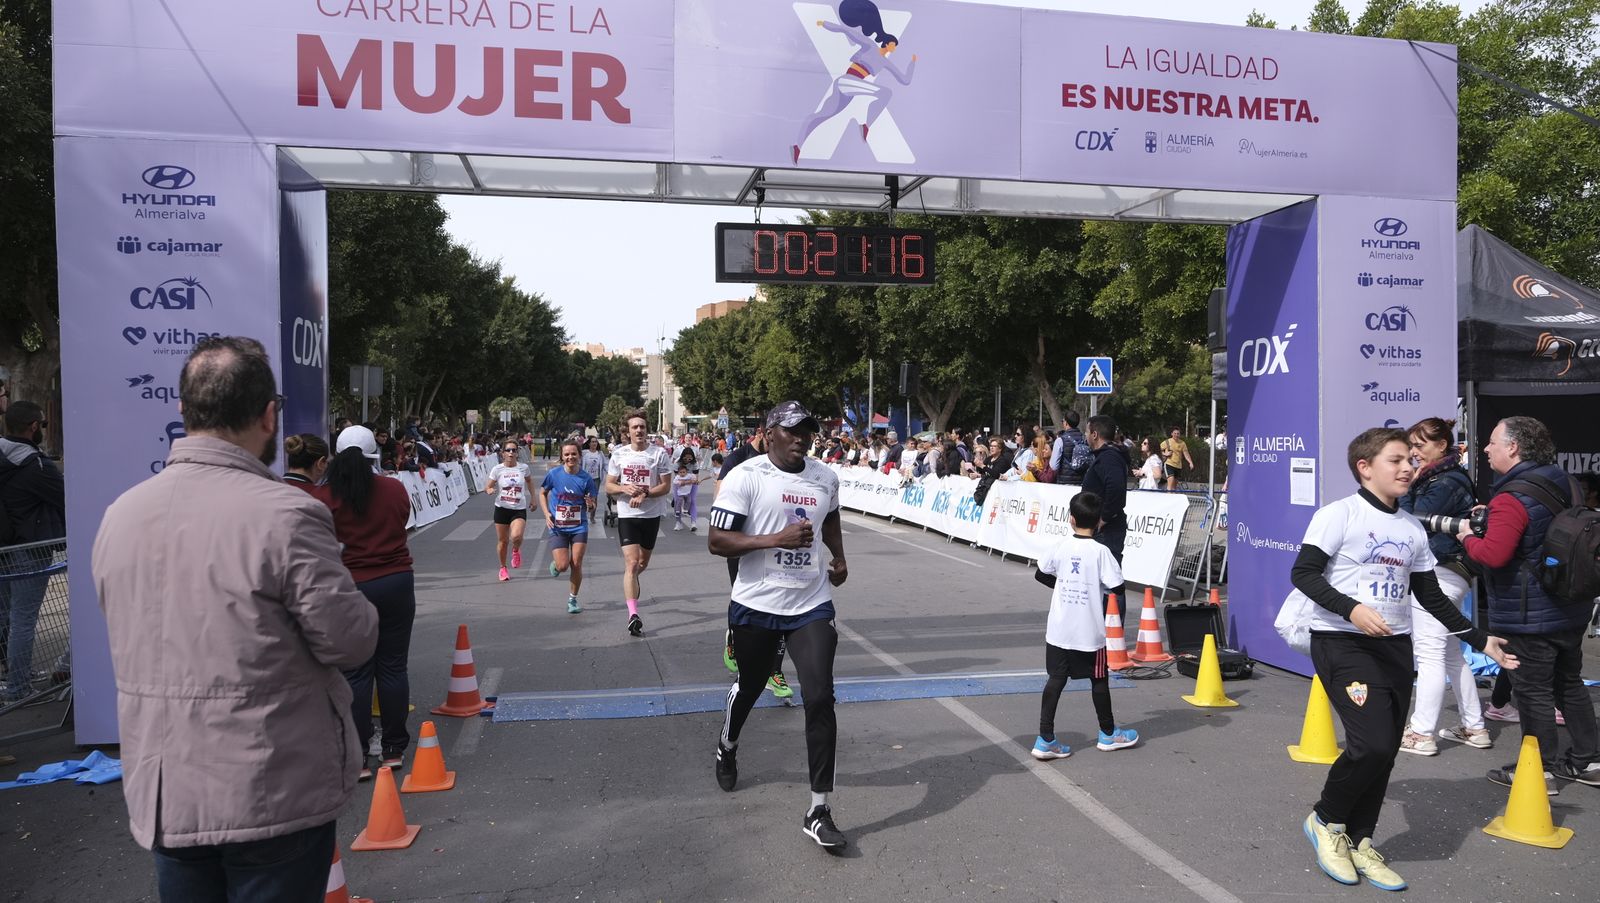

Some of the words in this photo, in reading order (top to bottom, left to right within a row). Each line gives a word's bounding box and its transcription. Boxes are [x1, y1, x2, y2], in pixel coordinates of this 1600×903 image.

[317, 0, 496, 28] CARRERA
[509, 2, 555, 32] DE
[569, 5, 612, 35] LA
[1106, 45, 1138, 70] LA
[1146, 48, 1279, 81] IGUALDAD
[297, 33, 631, 124] MUJER
[1062, 83, 1097, 109] ES
[1104, 85, 1233, 119] NUESTRA
[1238, 96, 1320, 124] META.
[1075, 127, 1119, 152] CDX
[1166, 133, 1215, 148] ALMERÍA
[1166, 146, 1192, 154] CIUDAD
[121, 192, 216, 207] HYUNDAI
[135, 208, 206, 221] Almerialva
[146, 238, 223, 255] cajamar
[1361, 239, 1421, 250] HYUNDAI
[754, 230, 925, 278] 00:21:16
[1369, 251, 1414, 261] Almerialva
[1376, 274, 1425, 288] cajamar
[130, 286, 196, 310] CASI
[1365, 312, 1407, 332] CASI
[292, 315, 324, 369] CDX
[1239, 323, 1298, 378] CDX
[153, 348, 170, 356] vivir
[1378, 345, 1422, 359] vithas
[141, 386, 180, 404] aqu
[1370, 388, 1421, 405] aqualia
[1252, 433, 1306, 452] ALMERÍA
[1252, 453, 1278, 463] CIUDAD
[782, 493, 818, 507] MUJER
[561, 510, 576, 519] 594
[1125, 513, 1175, 537] LMERÍA
[774, 551, 812, 566] 1352
[1369, 581, 1405, 599] 1182
